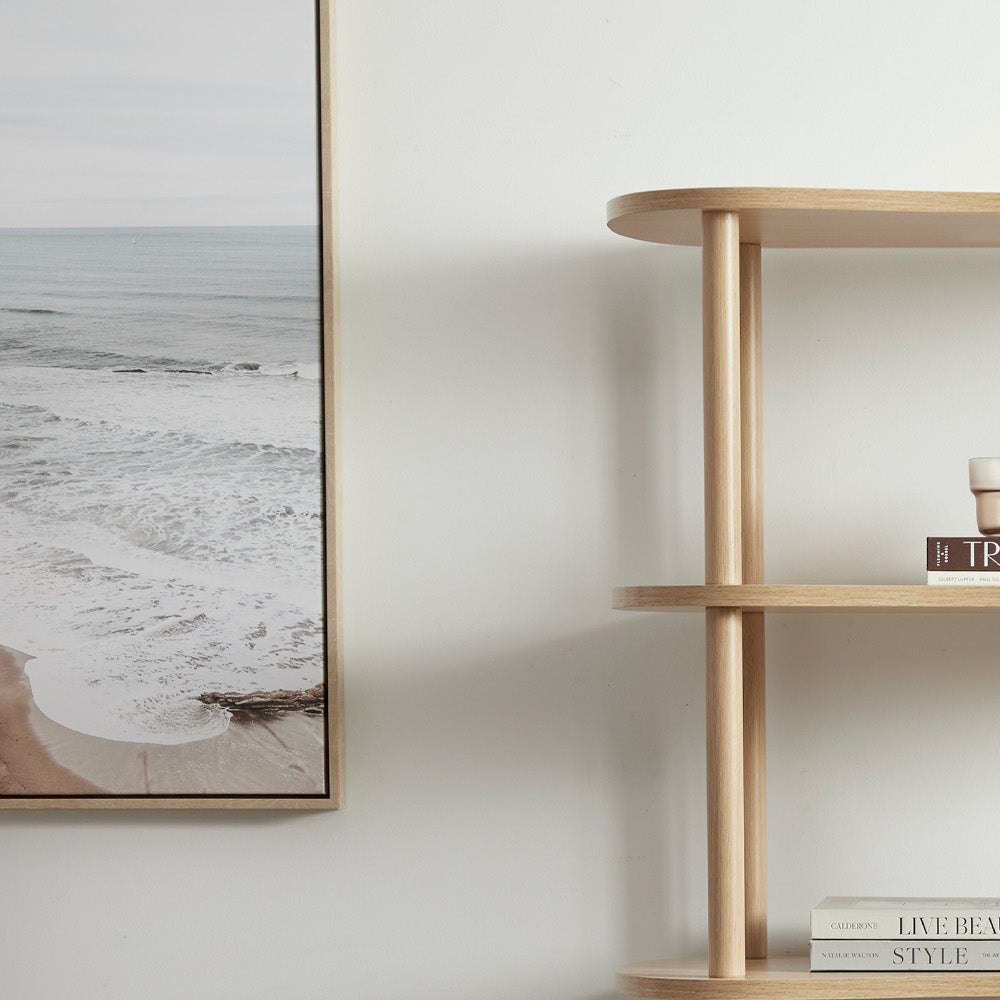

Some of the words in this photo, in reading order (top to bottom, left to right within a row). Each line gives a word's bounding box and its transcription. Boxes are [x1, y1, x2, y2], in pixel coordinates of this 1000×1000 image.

[830, 922, 878, 930] CALDERONE
[899, 916, 948, 935] LIVE
[892, 947, 969, 965] STYLE
